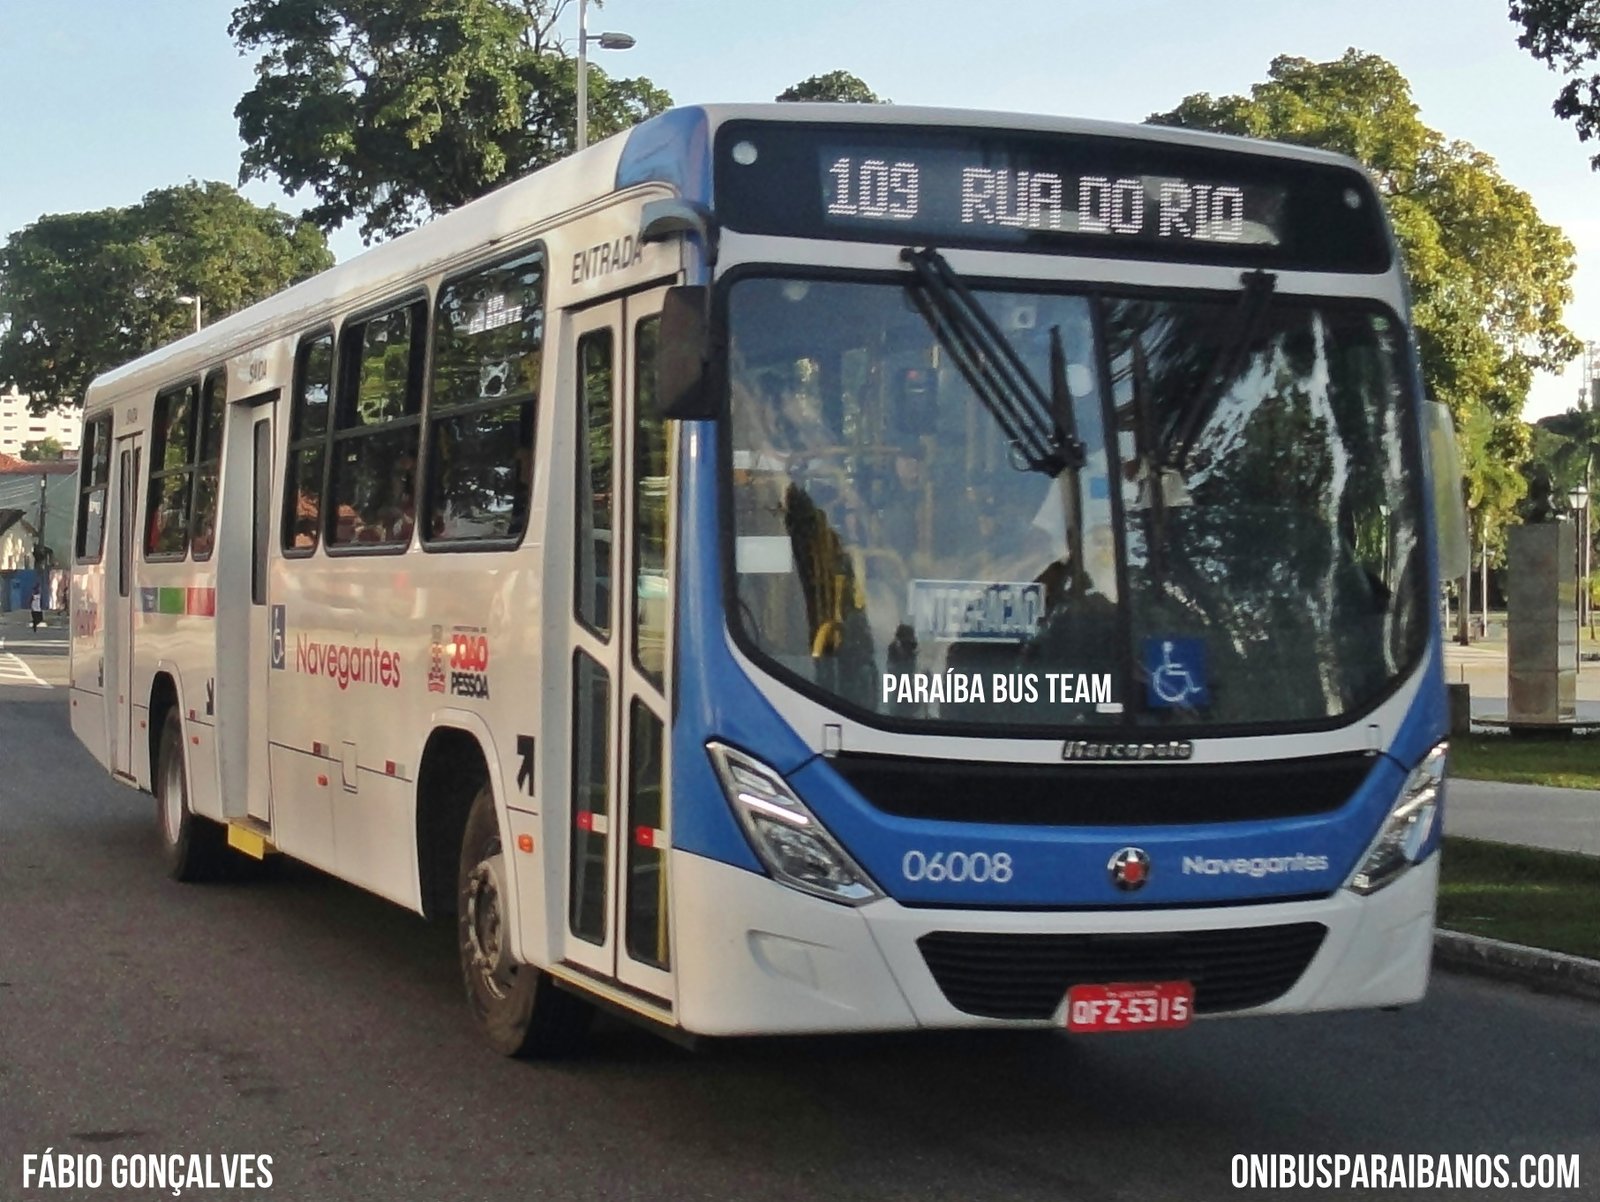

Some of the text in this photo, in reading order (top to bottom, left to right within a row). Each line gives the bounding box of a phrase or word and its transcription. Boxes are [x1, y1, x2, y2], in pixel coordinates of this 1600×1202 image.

[828, 157, 1244, 240] 109 RUA DO RIO
[571, 228, 643, 285] ENTRADA
[297, 632, 400, 690] Navegantes
[451, 671, 490, 699] PESSOA
[902, 850, 1013, 883] 06008
[1182, 852, 1329, 878] Navegantes
